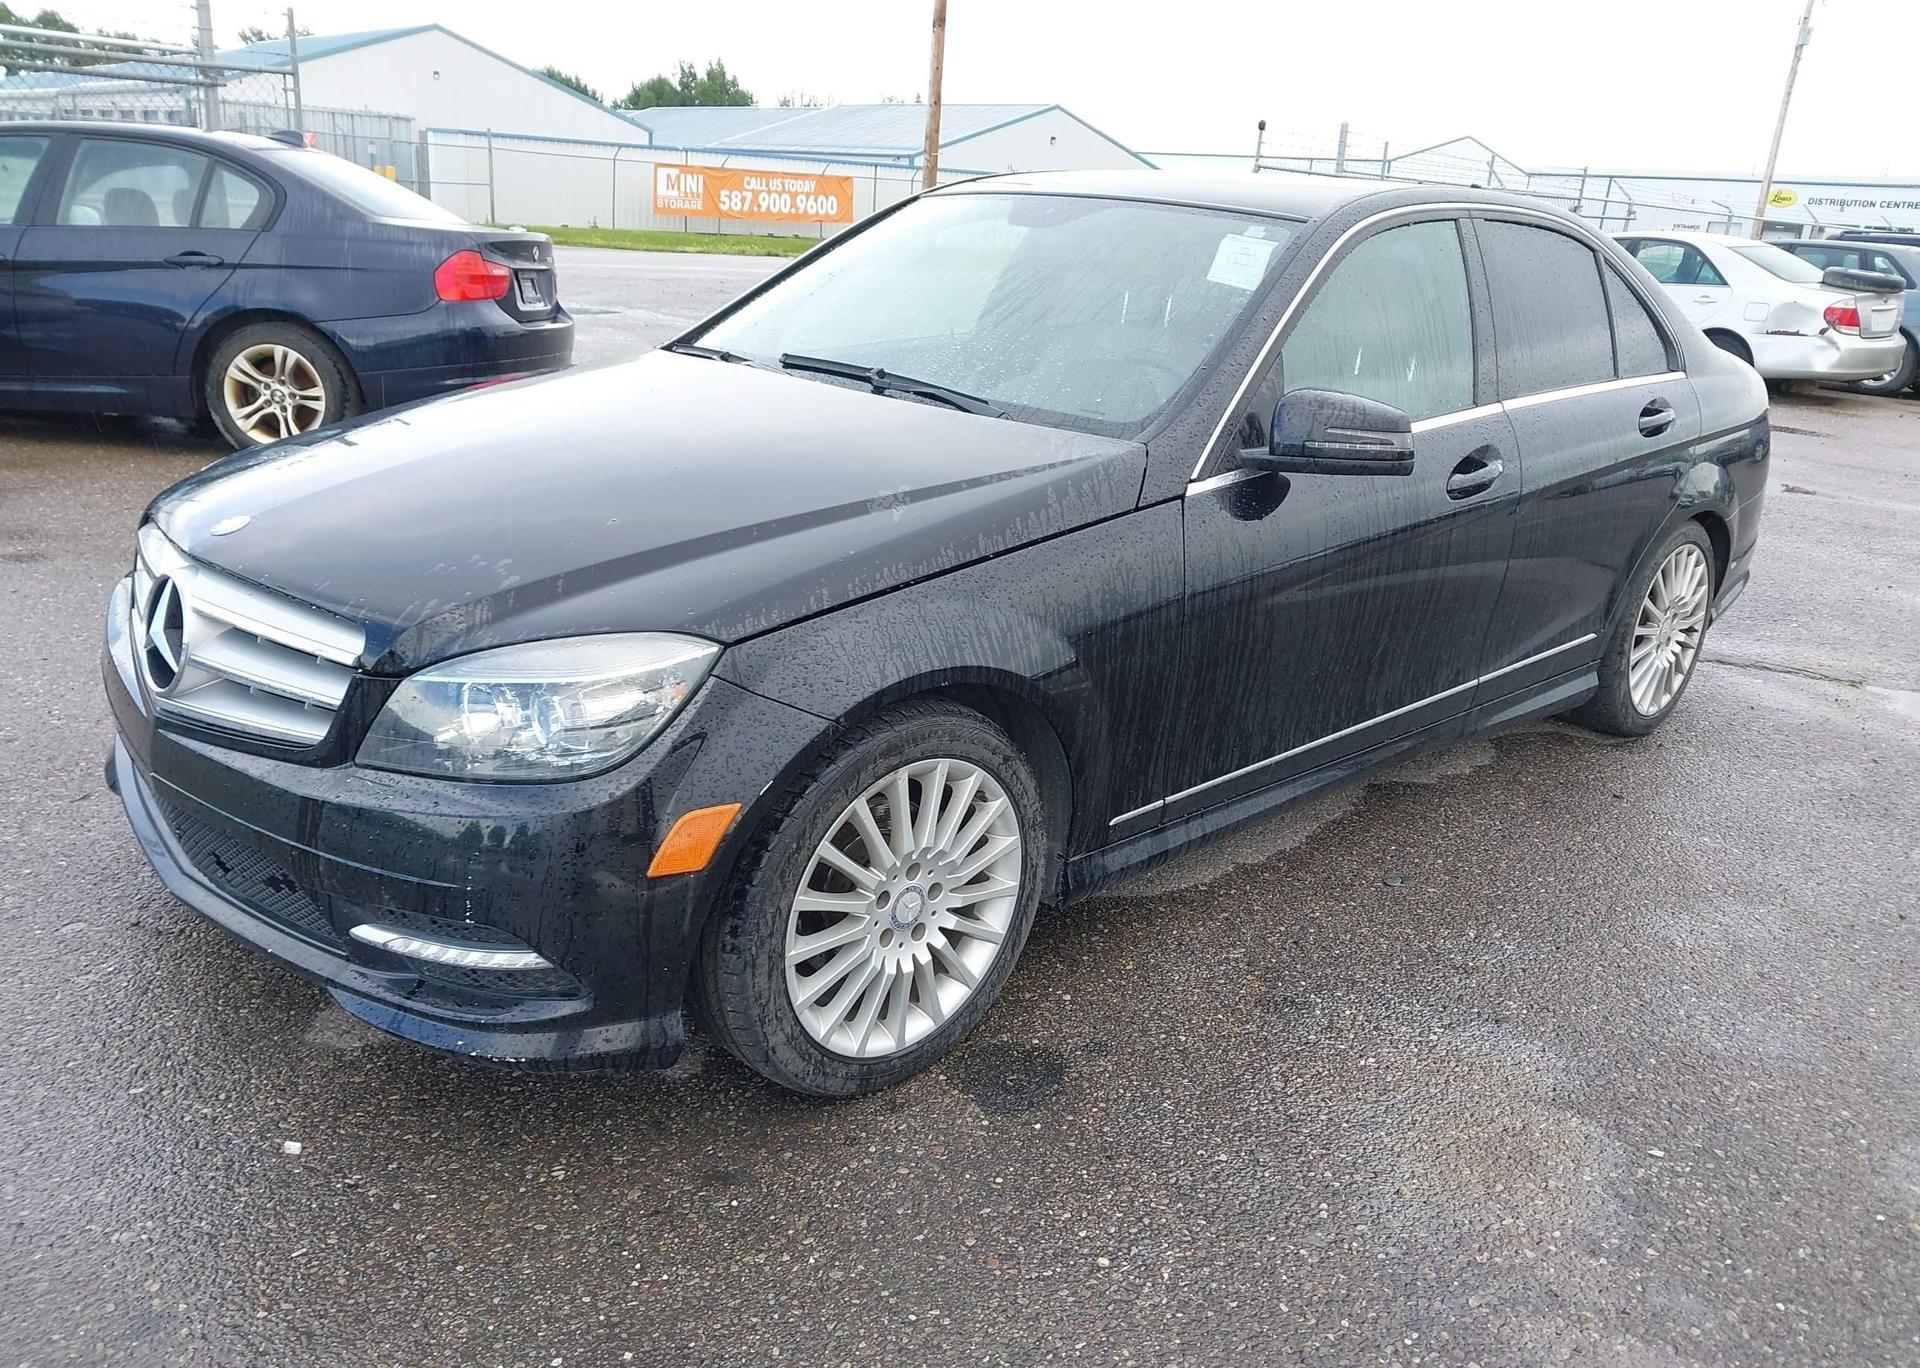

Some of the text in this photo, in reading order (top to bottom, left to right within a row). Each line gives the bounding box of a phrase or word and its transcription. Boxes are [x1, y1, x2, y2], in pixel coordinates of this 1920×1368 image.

[664, 171, 704, 193] MINI
[743, 176, 816, 192] CALL US TODAY
[656, 199, 704, 211] STORAGE
[719, 189, 838, 215] 587.900.9600
[1807, 197, 1920, 210] DISTRIBUTION CENTRE
